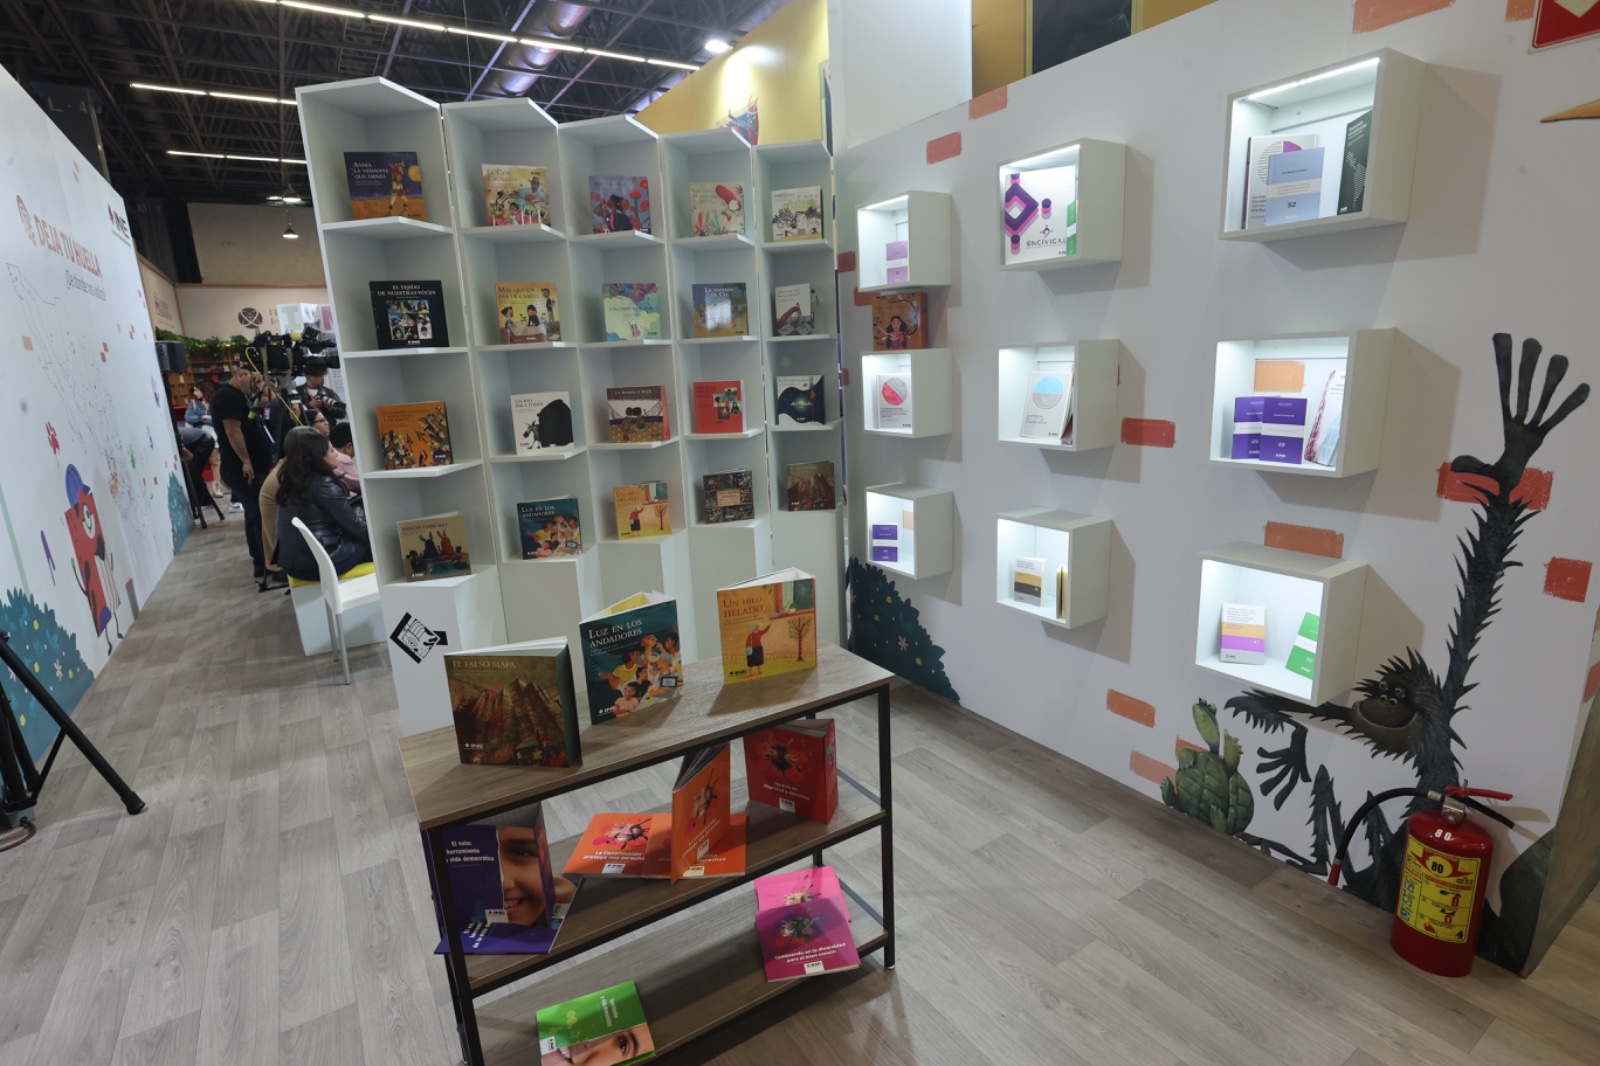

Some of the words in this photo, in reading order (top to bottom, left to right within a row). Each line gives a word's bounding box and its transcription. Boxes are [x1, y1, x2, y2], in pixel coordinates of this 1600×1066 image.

[723, 599, 739, 608] UN
[742, 596, 762, 605] HILO
[723, 605, 763, 618] HELADO
[588, 628, 609, 639] LUZ
[612, 624, 624, 633] EN
[626, 618, 643, 629] LOS
[589, 628, 643, 649] ANDADORES
[464, 660, 491, 668] FALSO
[492, 660, 516, 669] MAPA
[1431, 861, 1444, 874] 80
[774, 950, 804, 960] Caminando
[818, 942, 846, 951] diversidad
